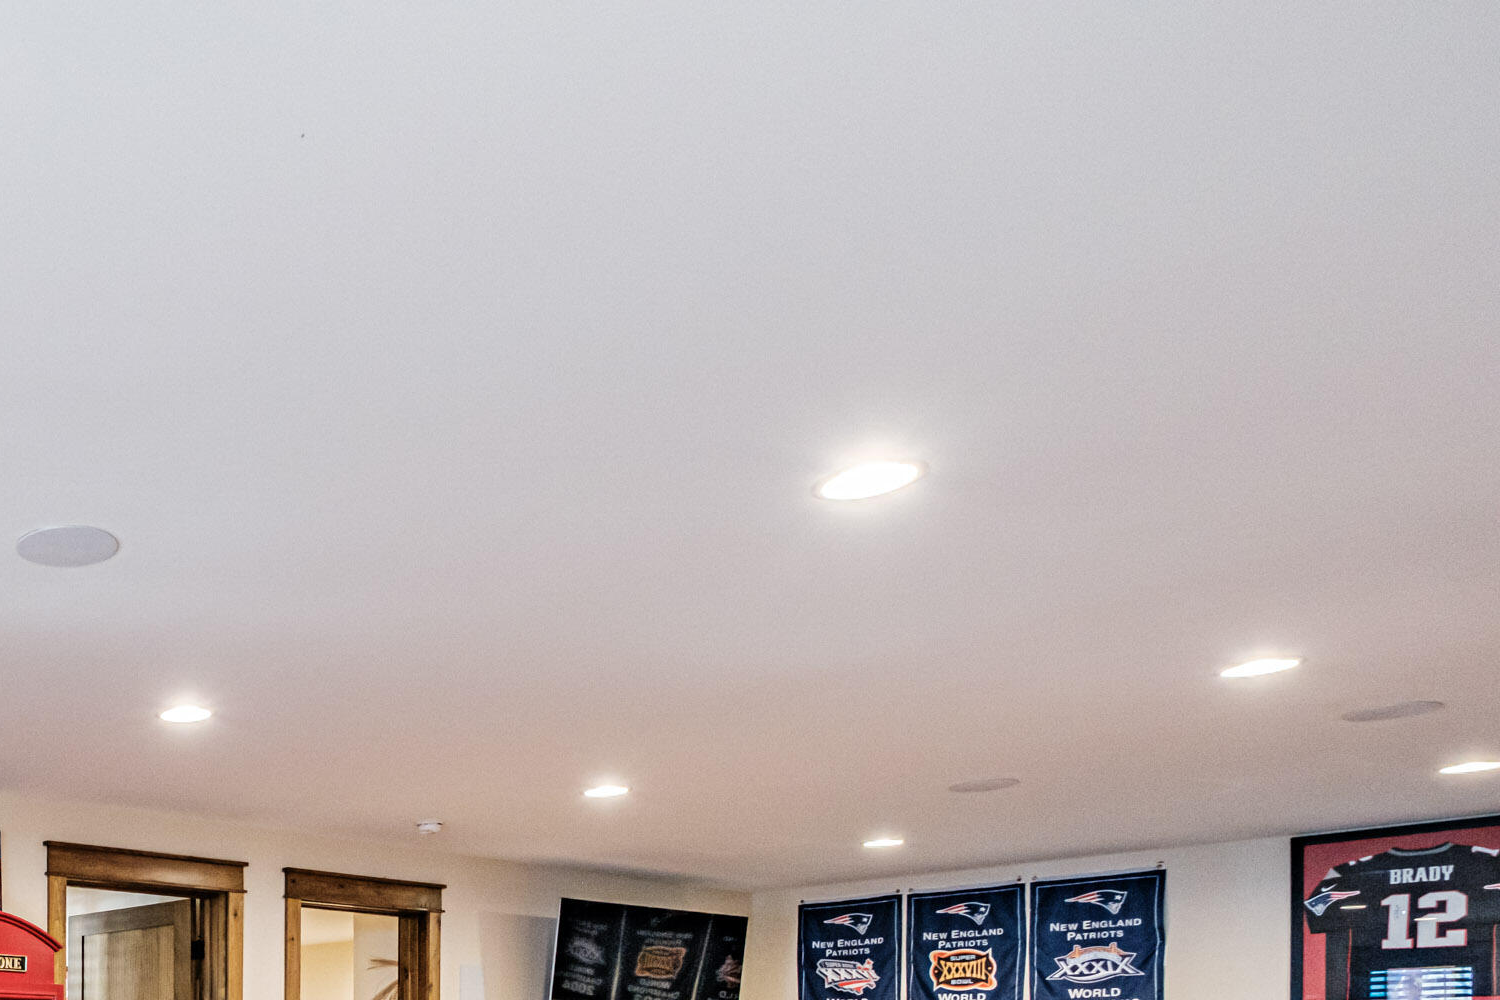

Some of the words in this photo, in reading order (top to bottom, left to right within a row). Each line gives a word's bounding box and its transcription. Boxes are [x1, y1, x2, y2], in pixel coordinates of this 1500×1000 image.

[1389, 865, 1455, 885] BRADY
[1050, 922, 1078, 932] NEW
[1082, 918, 1142, 930] ENGLAND
[1380, 890, 1468, 950] 12
[922, 932, 948, 941] NEW
[951, 927, 1004, 939] ENGLAND
[1067, 930, 1124, 941] PATRIOTS
[812, 940, 834, 949] NEW
[837, 937, 884, 948] ENGLAND
[938, 939, 989, 949] PATRIOTS
[825, 948, 870, 957] PATRIOTS
[939, 957, 987, 983] XXXVIII
[1068, 987, 1121, 999] WORLD
